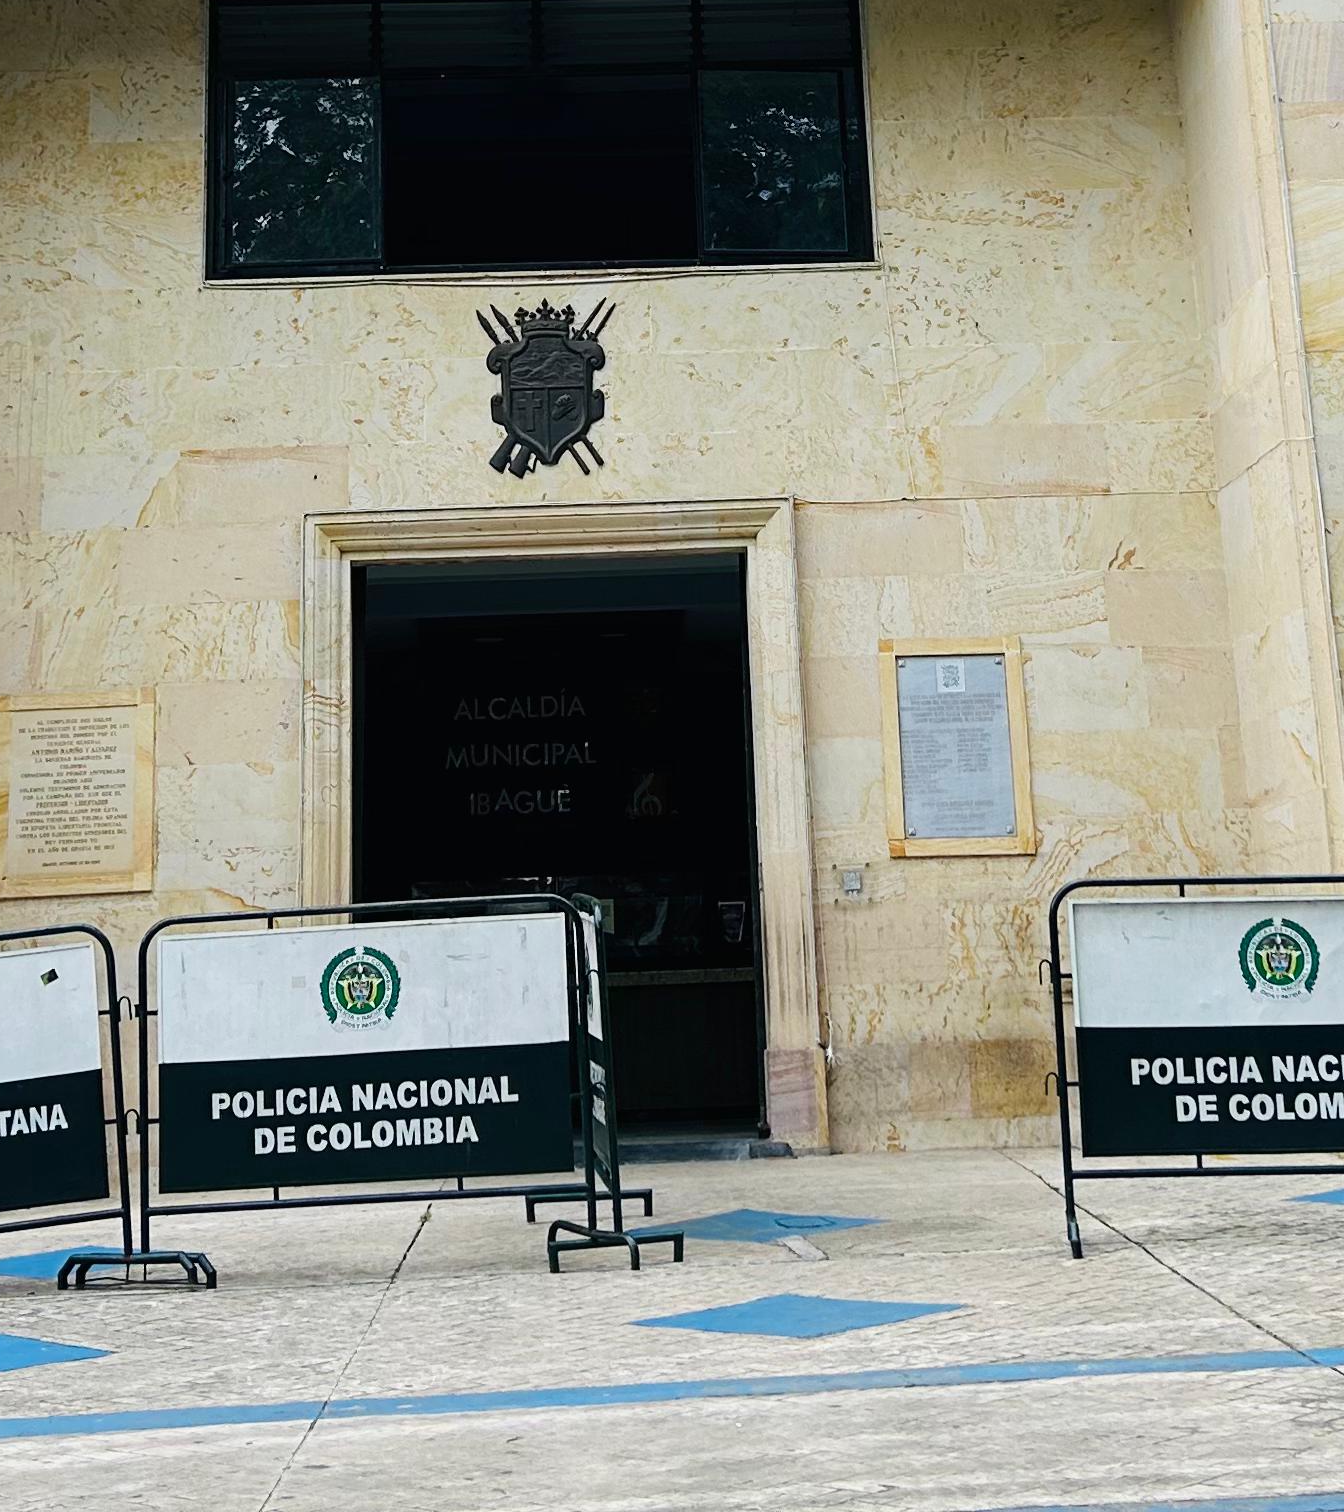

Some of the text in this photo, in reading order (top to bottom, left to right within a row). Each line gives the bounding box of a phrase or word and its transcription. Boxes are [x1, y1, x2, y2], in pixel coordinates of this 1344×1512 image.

[453, 688, 587, 722] ALCALDÍA
[445, 742, 597, 770] MUNICIPAL
[469, 783, 571, 816] IBAGUÉ
[1130, 1055, 1264, 1086] POLICIA
[211, 1075, 519, 1120] POLICIA NACIONAL
[1175, 1094, 1220, 1123] DE
[254, 1115, 479, 1156] DE COLOMBIA
